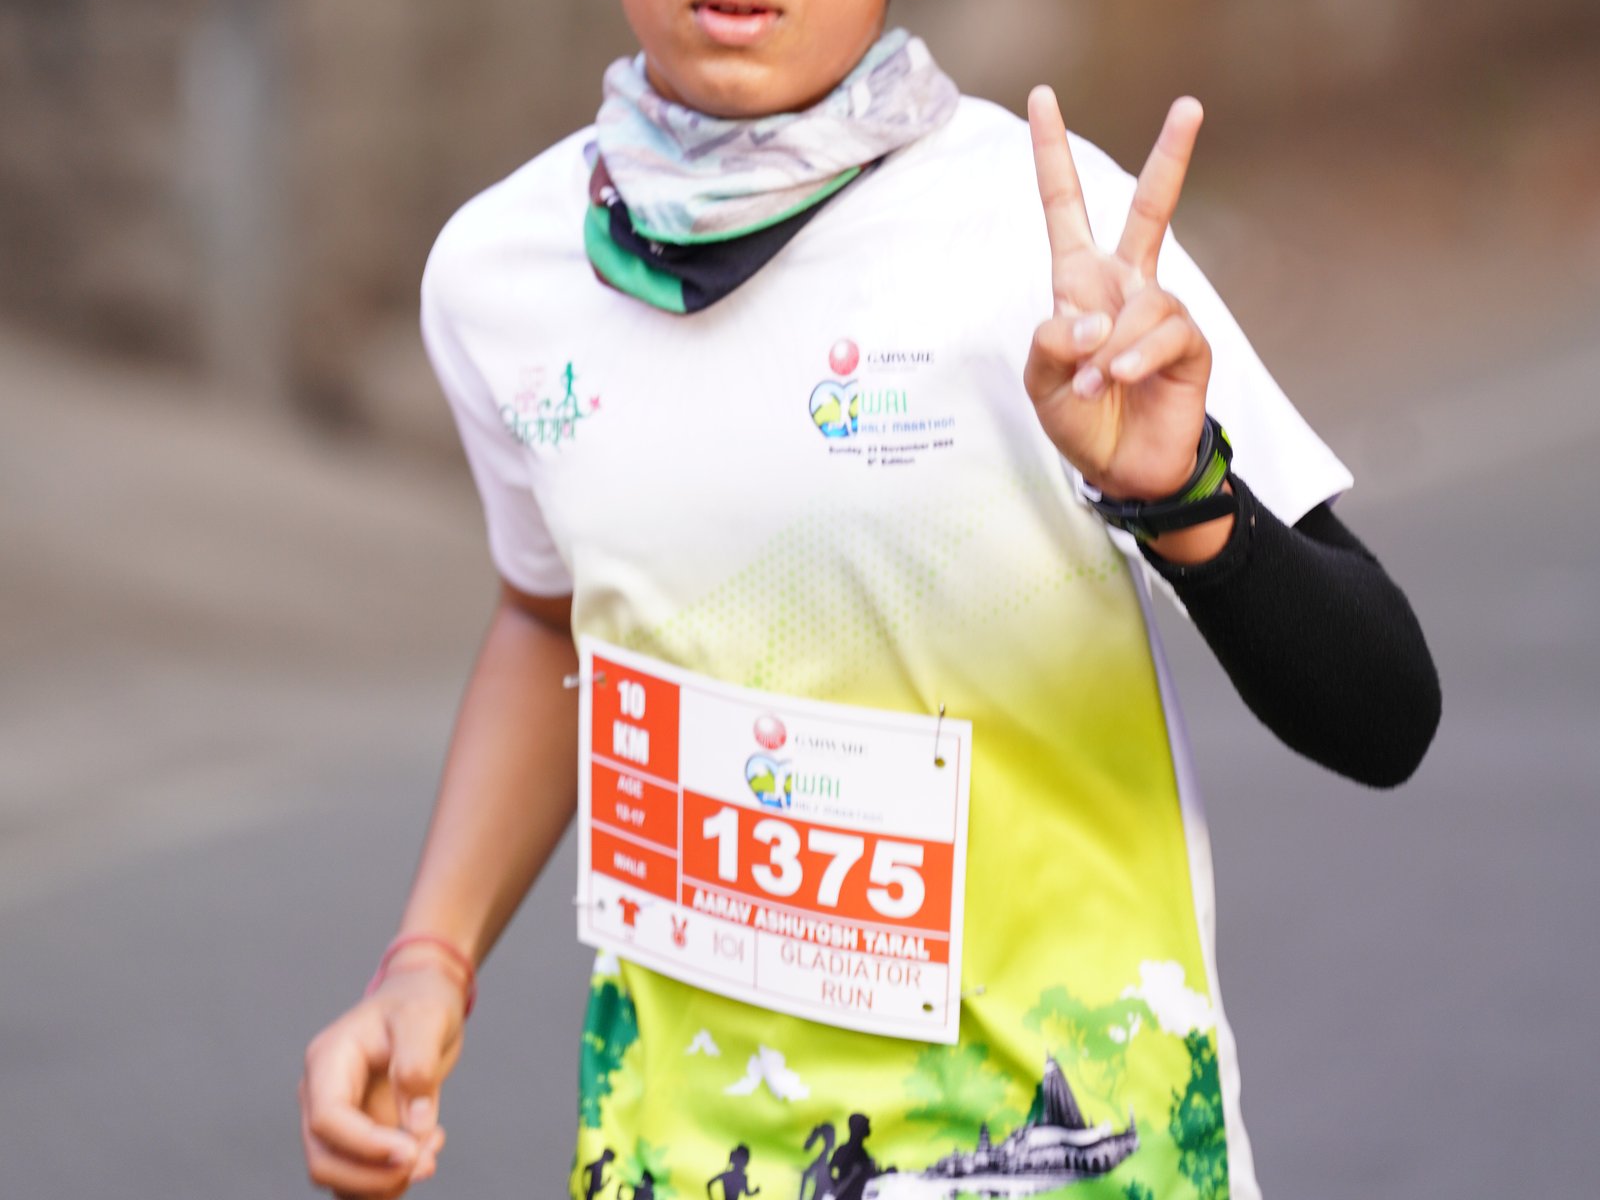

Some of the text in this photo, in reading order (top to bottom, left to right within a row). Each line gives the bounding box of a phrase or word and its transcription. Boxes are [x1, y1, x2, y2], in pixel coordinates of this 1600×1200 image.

[861, 390, 908, 415] WAI
[617, 680, 646, 719] 10
[613, 722, 650, 766] KM
[616, 775, 644, 800] AGE
[794, 770, 841, 800] WAI
[613, 852, 647, 880] MALE
[702, 808, 925, 919] 1375
[692, 889, 931, 961] AARAV ASHUTOSH TARAL
[780, 939, 921, 988] GLADIATOR
[821, 980, 873, 1010] RUN
